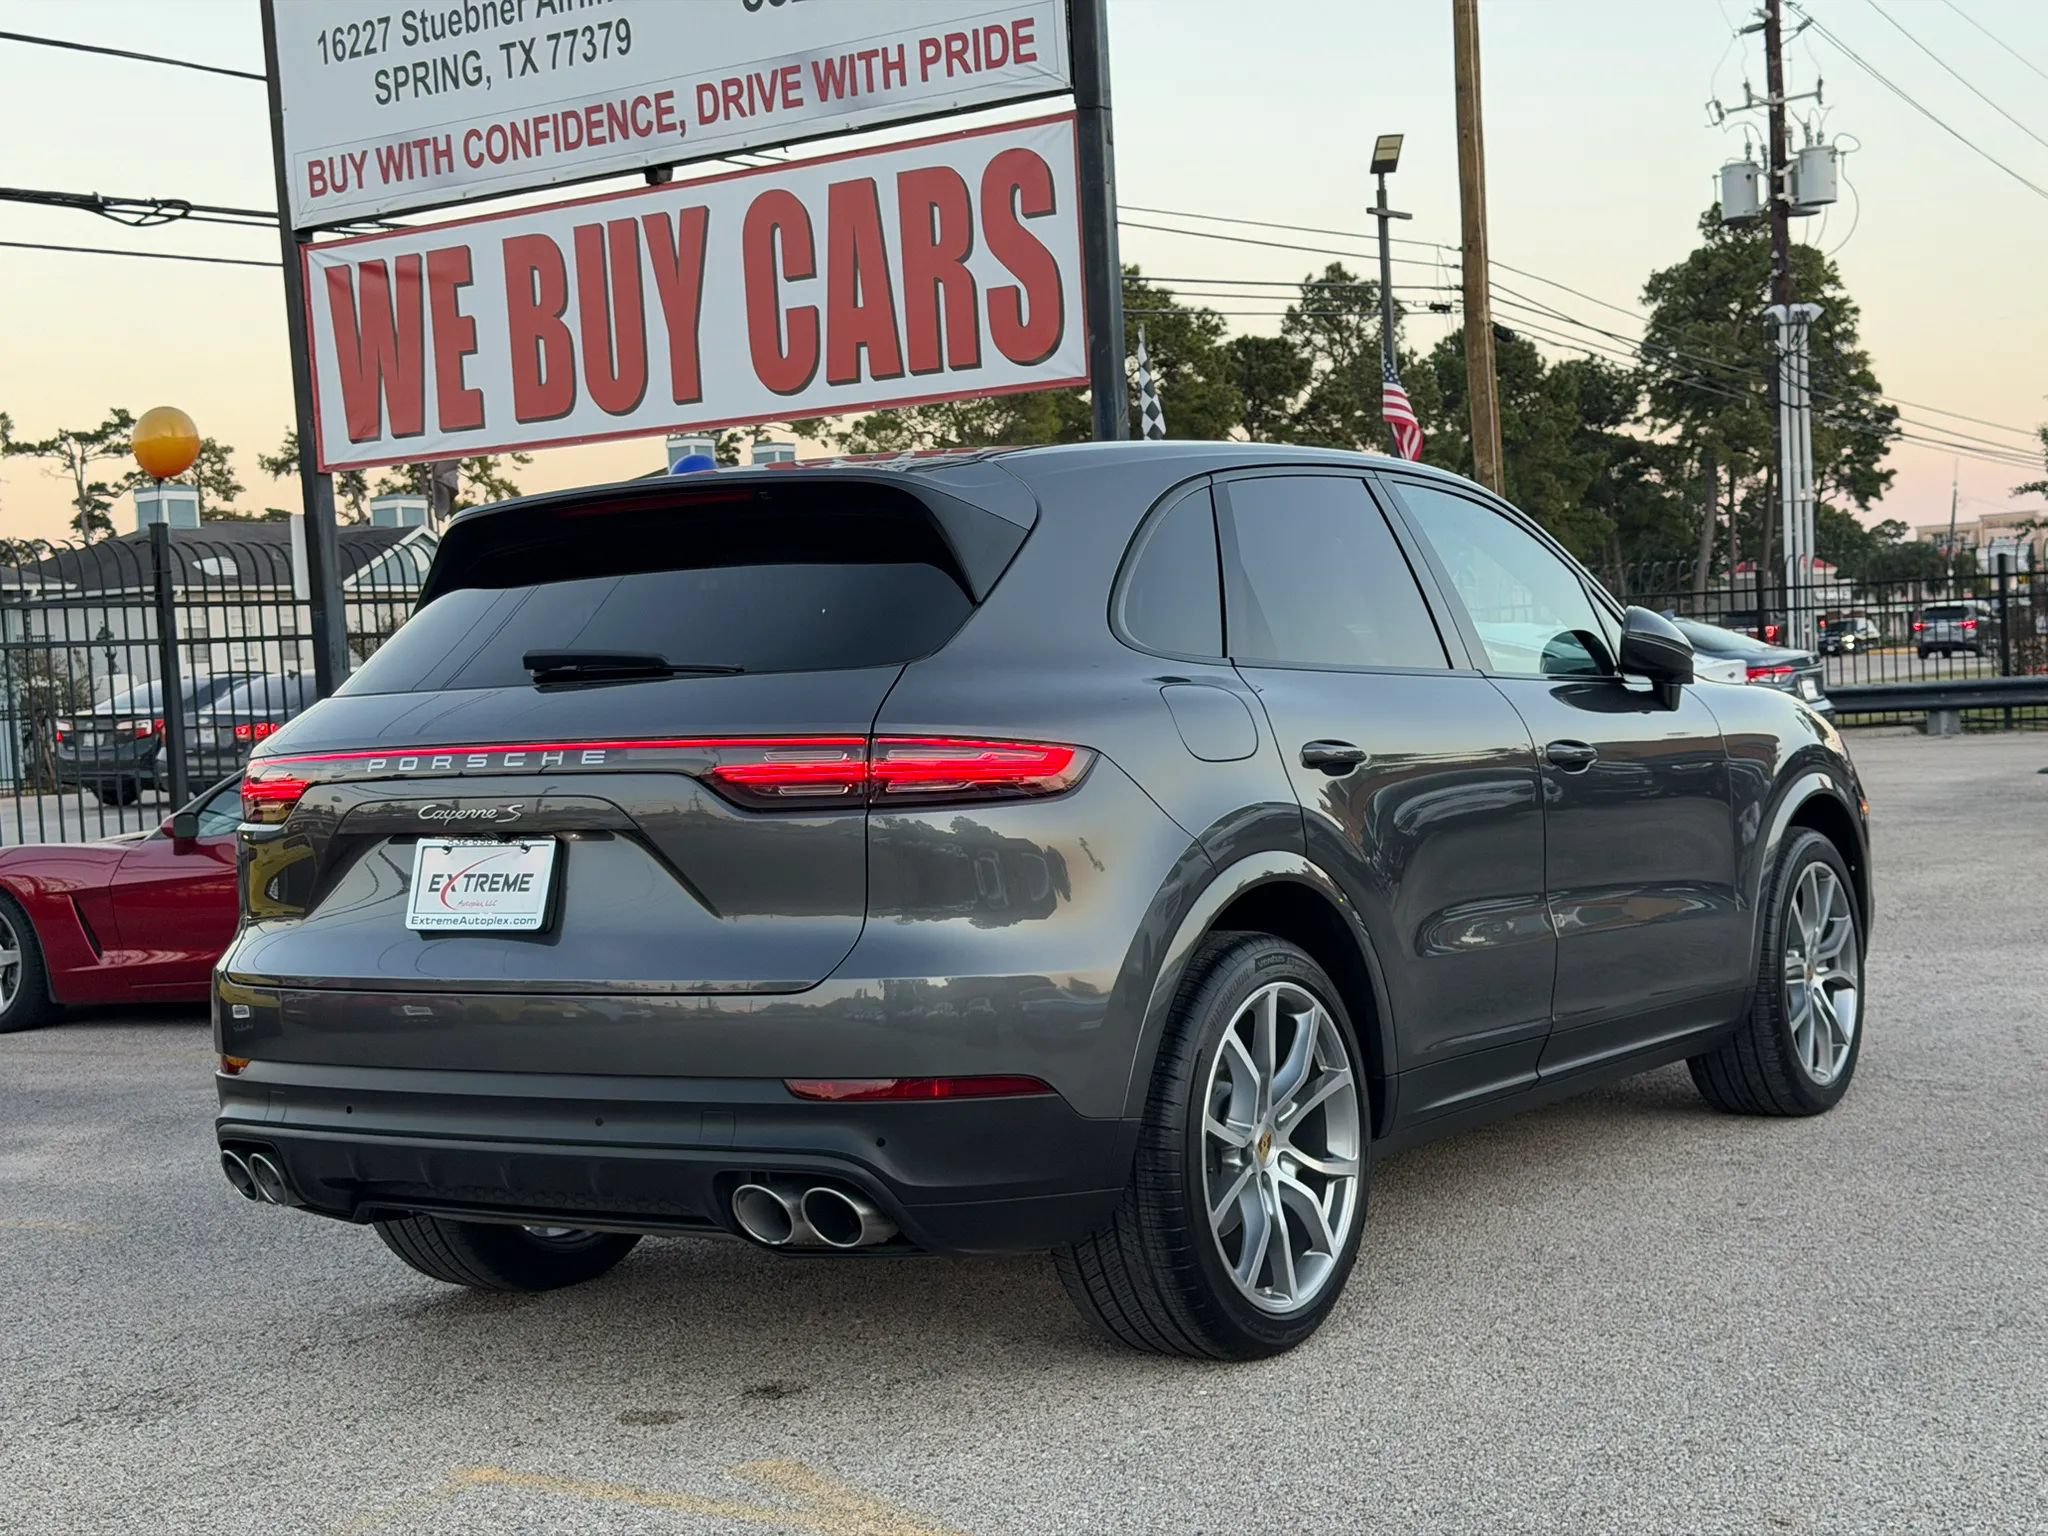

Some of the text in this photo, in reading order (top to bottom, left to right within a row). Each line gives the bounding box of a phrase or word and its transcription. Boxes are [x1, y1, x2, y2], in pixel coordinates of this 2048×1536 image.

[317, 0, 525, 65] 16227 Stuebner
[374, 17, 632, 106] SPRING, TX 77379
[307, 17, 1038, 198] BUY WITH CONFIDENCE, DRIVE WITH PRIDE
[325, 148, 1065, 444] WE BUY CARS
[367, 750, 606, 773] PORSCHE
[418, 804, 523, 826] Cayenne S
[427, 873, 535, 893] EXTREME
[410, 916, 537, 926] ExtremeAutoplex.com
